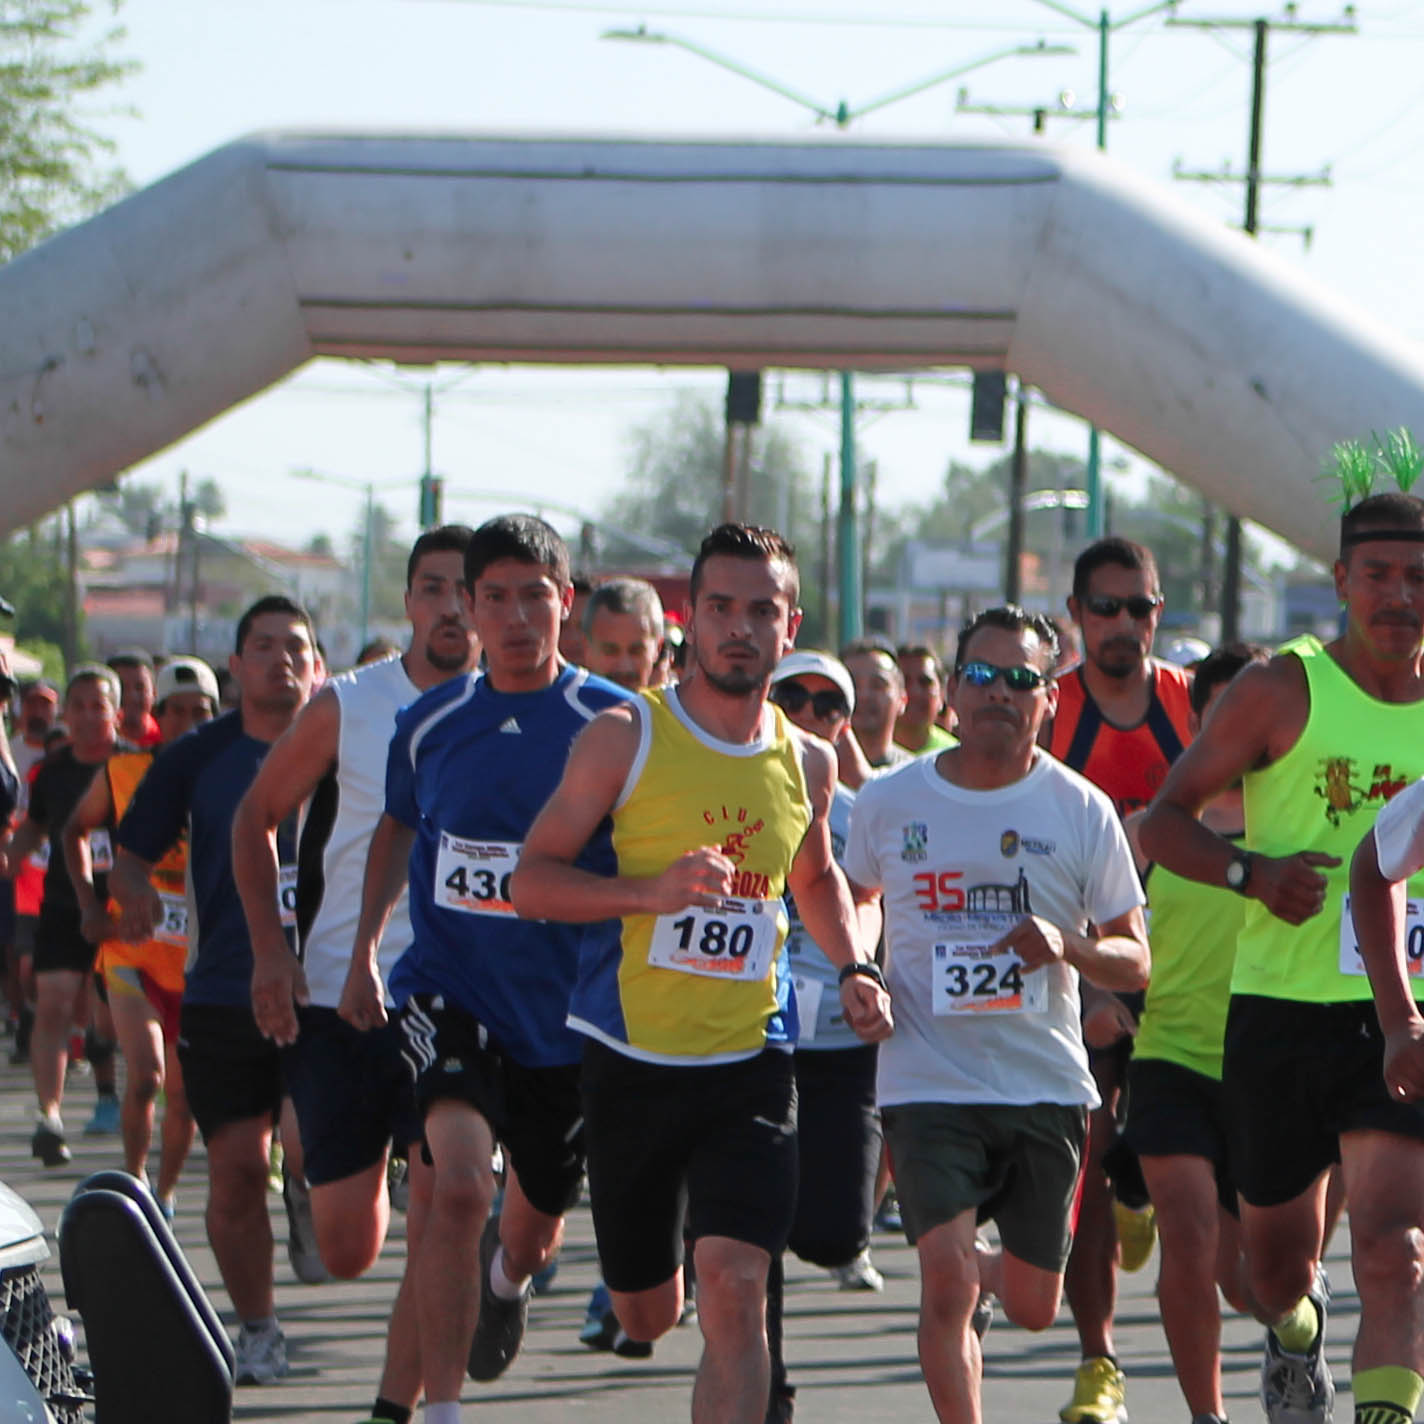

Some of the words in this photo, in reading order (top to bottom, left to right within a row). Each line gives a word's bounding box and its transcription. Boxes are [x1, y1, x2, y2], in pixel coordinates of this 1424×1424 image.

[913, 871, 965, 911] 35
[673, 916, 754, 958] 180
[945, 962, 1024, 997] 324
